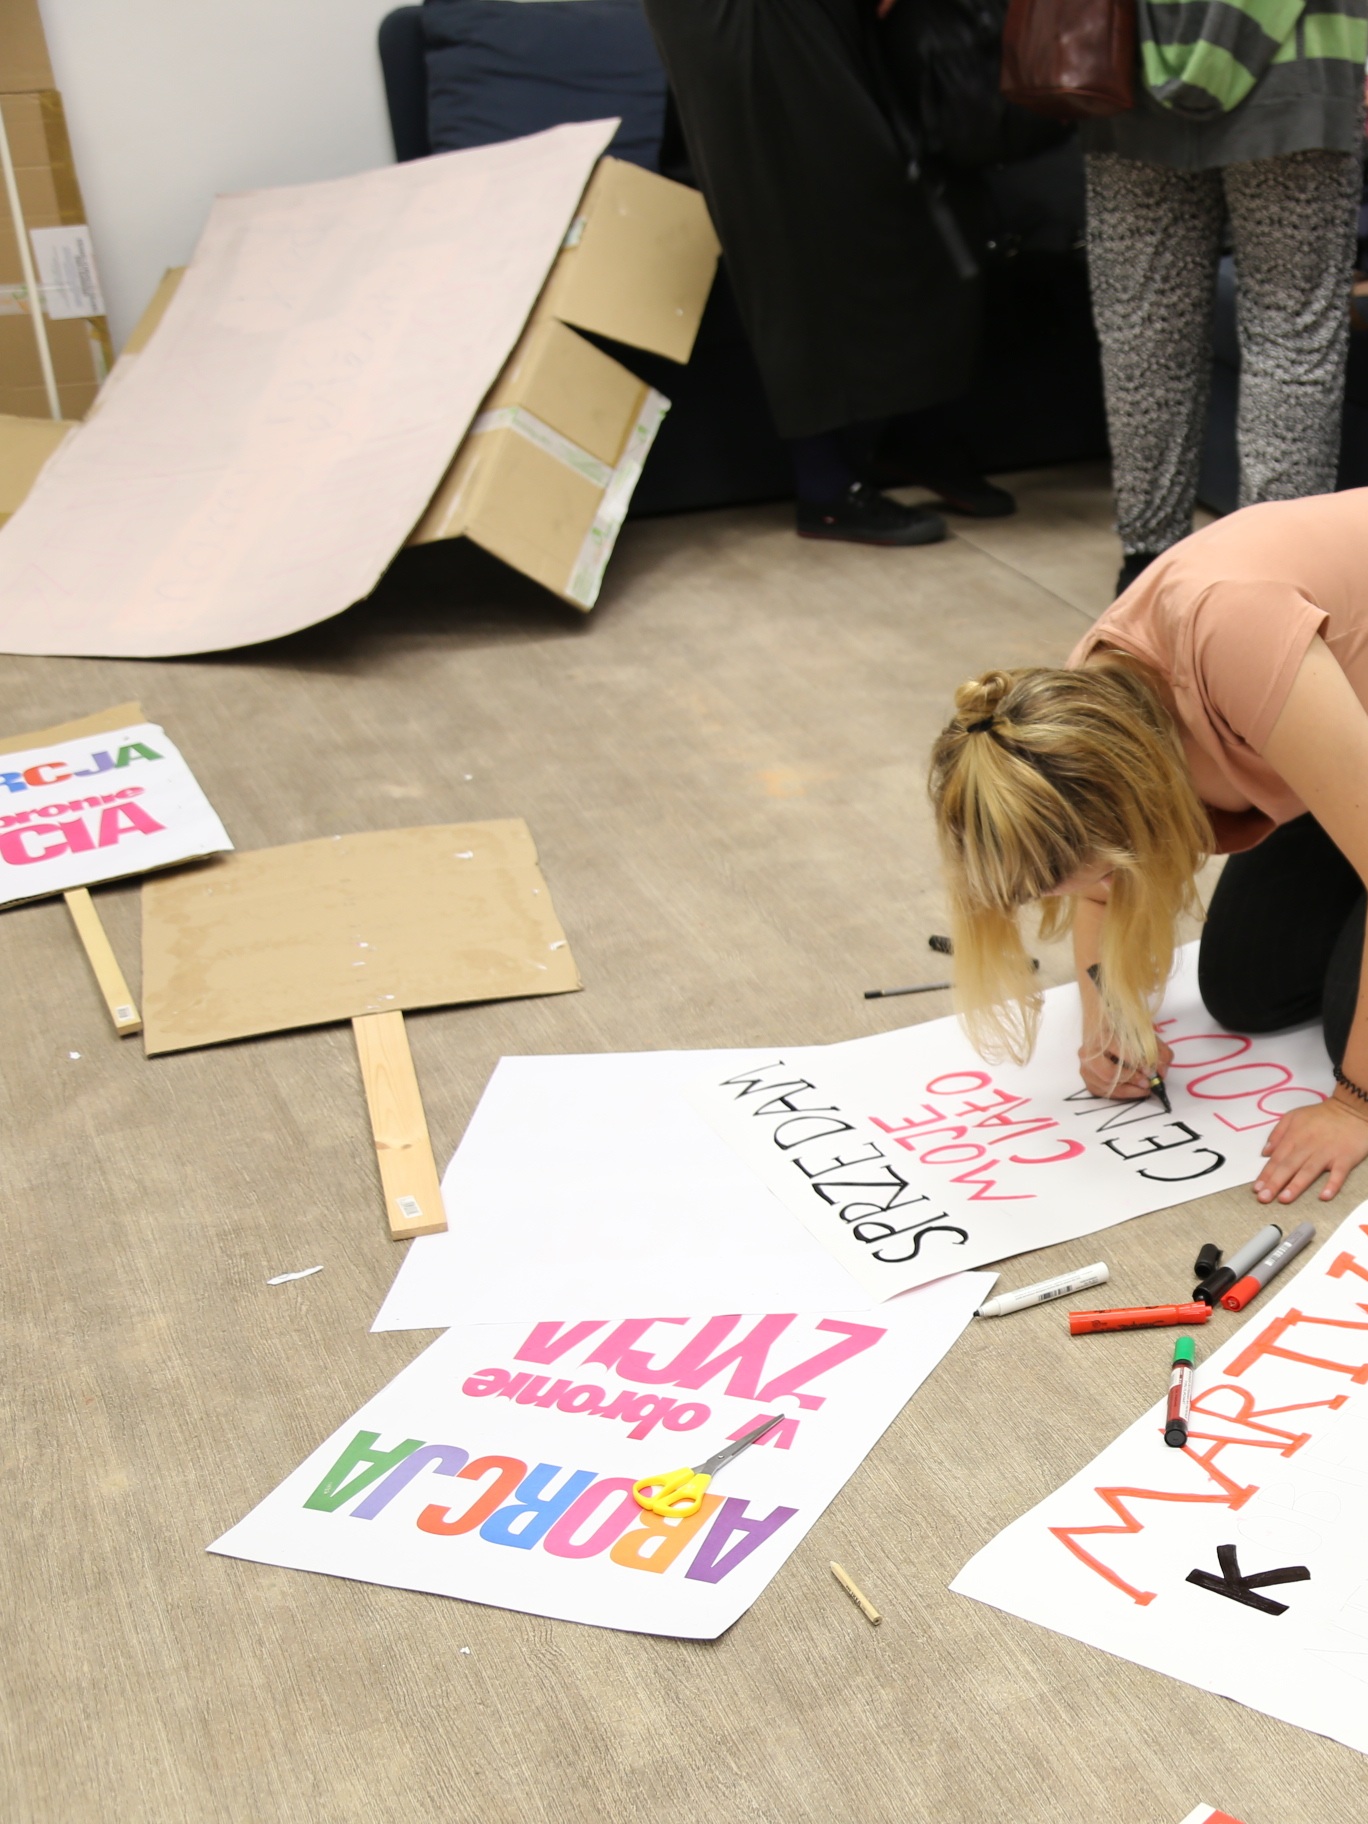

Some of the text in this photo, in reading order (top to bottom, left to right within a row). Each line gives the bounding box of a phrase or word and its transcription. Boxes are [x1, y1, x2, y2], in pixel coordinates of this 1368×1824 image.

[719, 1060, 969, 1263] SPRZEDAM
[870, 1105, 1036, 1202] MOJE
[924, 1070, 1086, 1165] CIAŁO
[461, 1367, 712, 1441] obronie
[302, 1430, 798, 1585] ABORCJA
